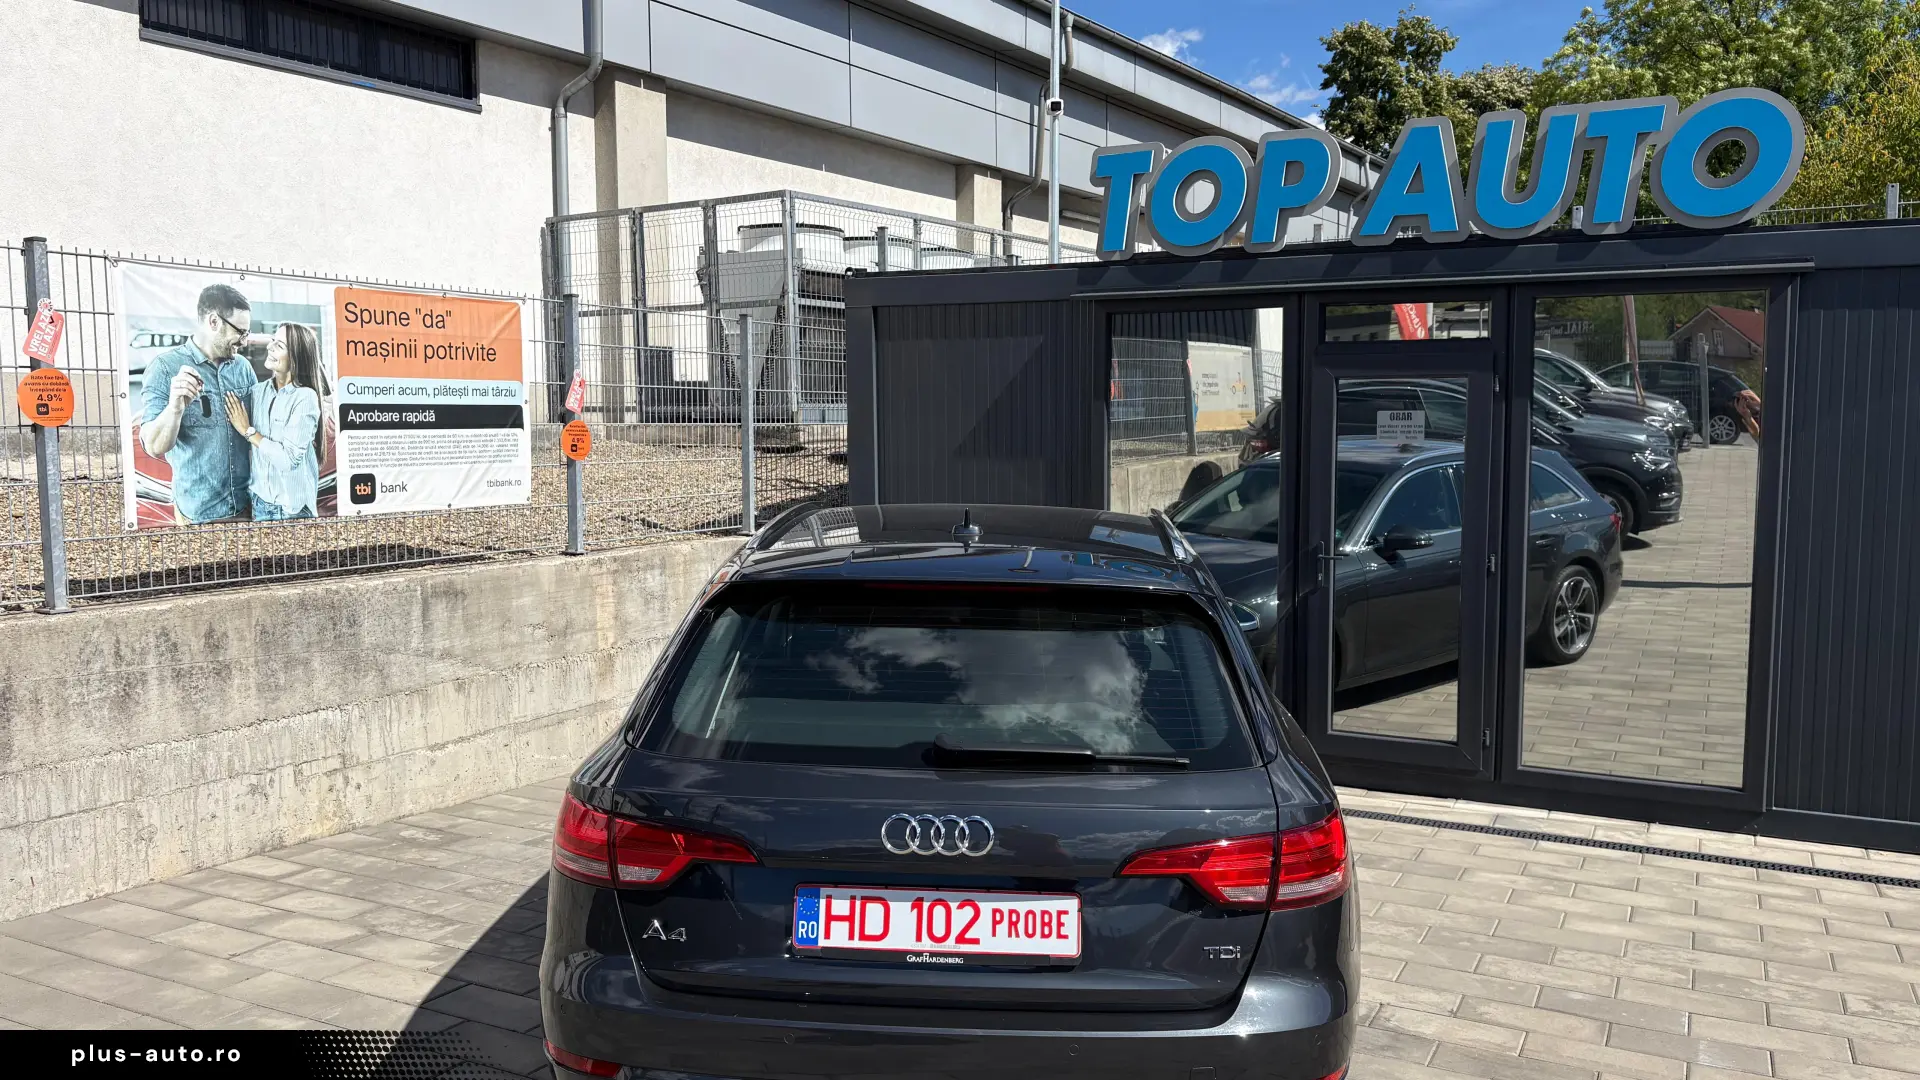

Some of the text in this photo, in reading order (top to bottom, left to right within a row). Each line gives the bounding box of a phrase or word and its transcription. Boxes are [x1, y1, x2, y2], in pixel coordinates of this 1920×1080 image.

[1094, 92, 1800, 256] TOP AUTO
[344, 302, 452, 329] Spune "da"
[27, 329, 45, 352] VREI
[346, 337, 497, 363] mașinii potrivite
[37, 393, 63, 402] 4.9%
[346, 382, 517, 399] Cumperi acum, plătești mai târziu
[347, 409, 436, 424] Aprobare rapidă
[354, 481, 408, 495] tbi bank
[486, 478, 522, 488] tbibank.ro
[641, 919, 687, 942] A4
[798, 894, 1070, 945] RO HD 102 PROBE
